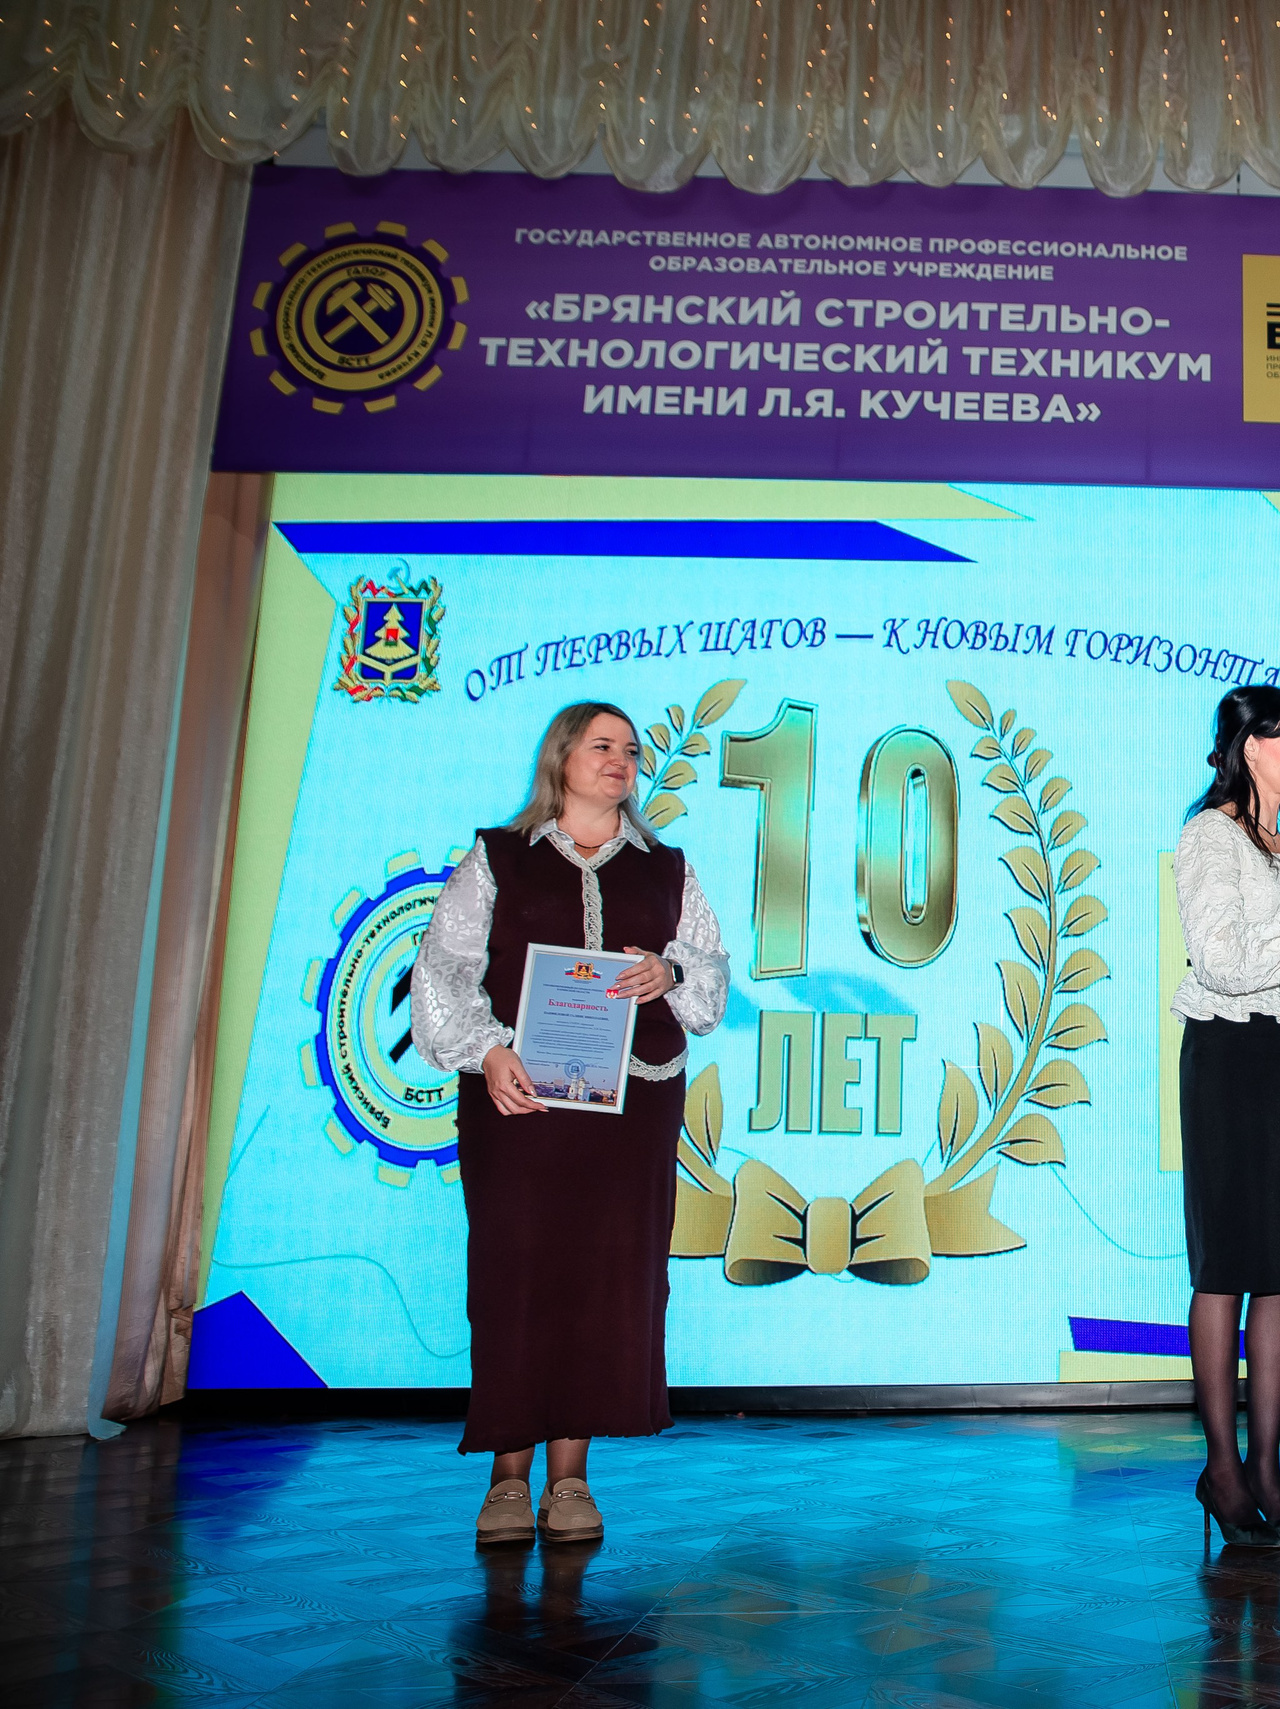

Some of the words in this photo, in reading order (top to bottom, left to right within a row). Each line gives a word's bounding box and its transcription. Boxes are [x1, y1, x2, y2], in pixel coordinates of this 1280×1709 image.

[514, 228, 751, 249] ГОСУДАРСТВЕННОЕ
[756, 233, 923, 253] АВТОНОМНОЕ
[928, 237, 1189, 262] ПРОФЕССИОНАЛЬНОЕ
[648, 255, 887, 277] ОБРАЗОВАТЕЛЬНОЕ
[892, 260, 1055, 282] УЧРЕЖДЕНИЕ
[524, 289, 803, 327] «БРЯНСКИЙ
[813, 297, 1172, 336] СТРОИТЕЛЬНО-
[479, 336, 949, 376] ТЕХНОЛОГИЧЕСКИЙ
[961, 346, 1213, 383] ТЕХНИКУМ
[583, 384, 748, 417] ИМЕНИ
[757, 387, 846, 419] Л.Я.
[858, 389, 1103, 424] КУЧЕЕВА»
[464, 642, 529, 702] ОТ
[534, 619, 694, 677] ПЕРВЫХ
[882, 617, 911, 655] К
[912, 616, 1056, 657] НОВЫМ
[719, 697, 960, 982] 10
[404, 1086, 444, 1104] БСТТ
[747, 1009, 918, 1136] ЛЕТ
